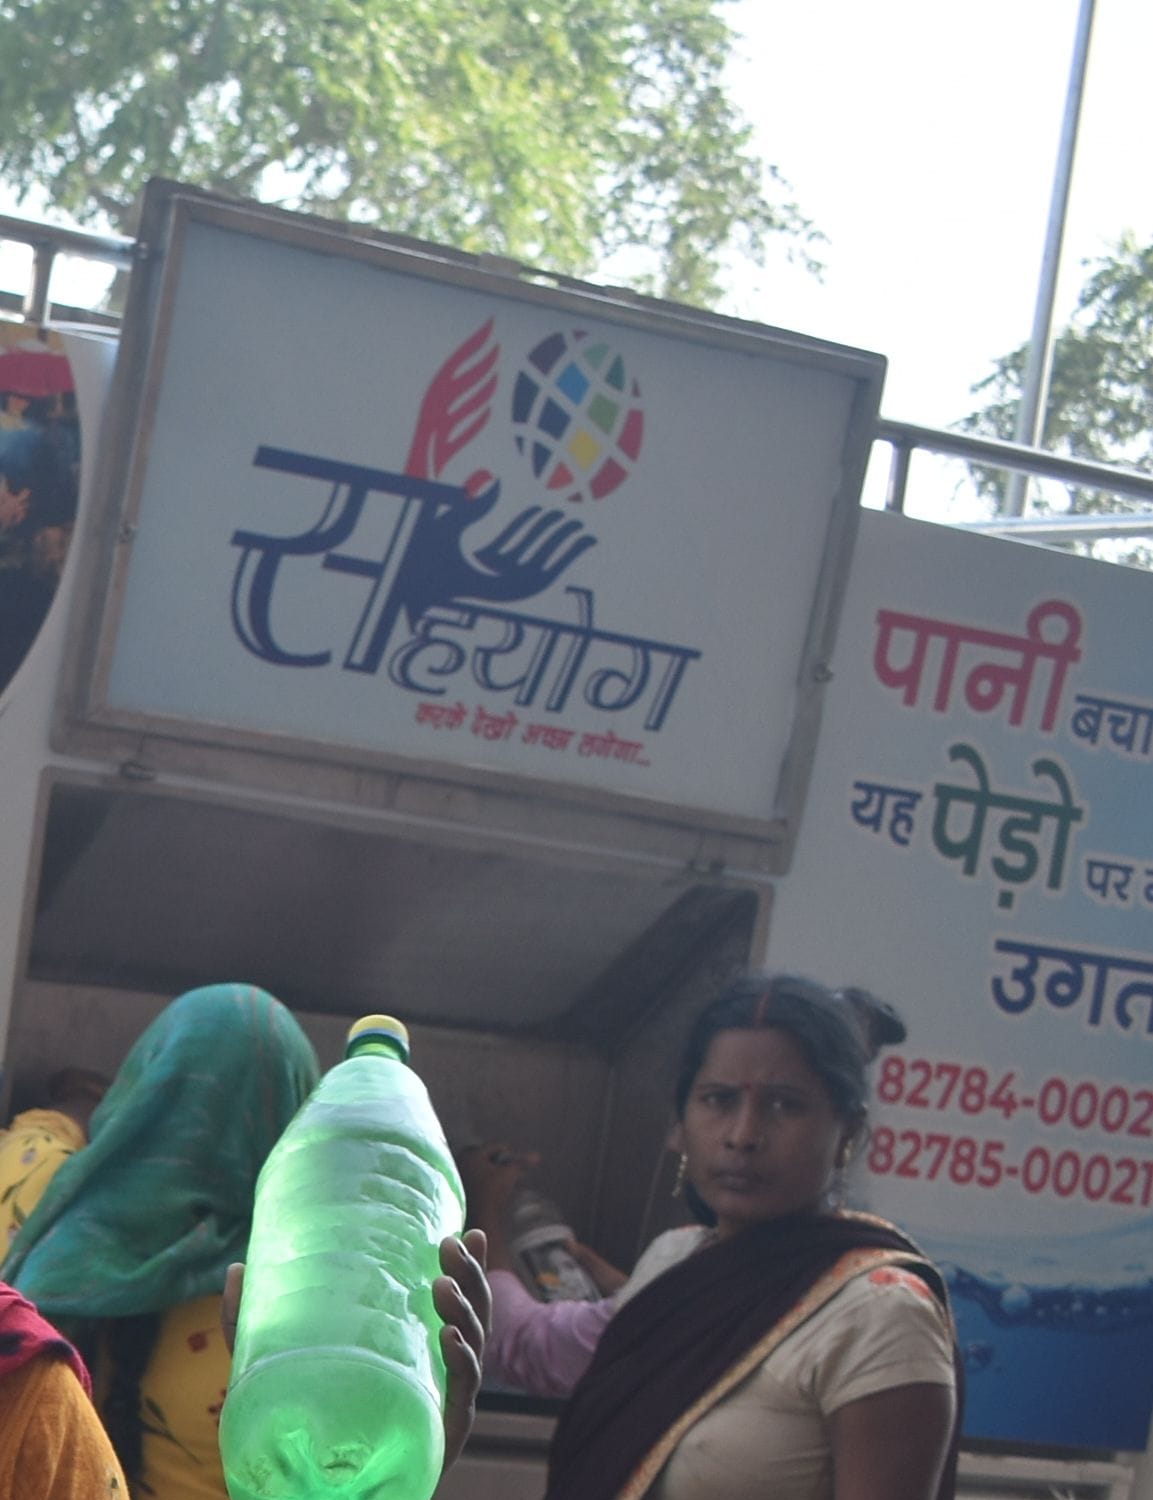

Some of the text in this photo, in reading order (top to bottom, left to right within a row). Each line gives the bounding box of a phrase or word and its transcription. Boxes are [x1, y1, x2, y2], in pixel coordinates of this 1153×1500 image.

[230, 445, 702, 732] सहयोग
[874, 599, 1153, 755] पानी बचा
[851, 781, 922, 845] यह
[1086, 860, 1134, 901] पर
[991, 939, 1153, 1035] उगत
[878, 1056, 1153, 1137] 82784-0002
[868, 1127, 1153, 1207] 82785-00021
